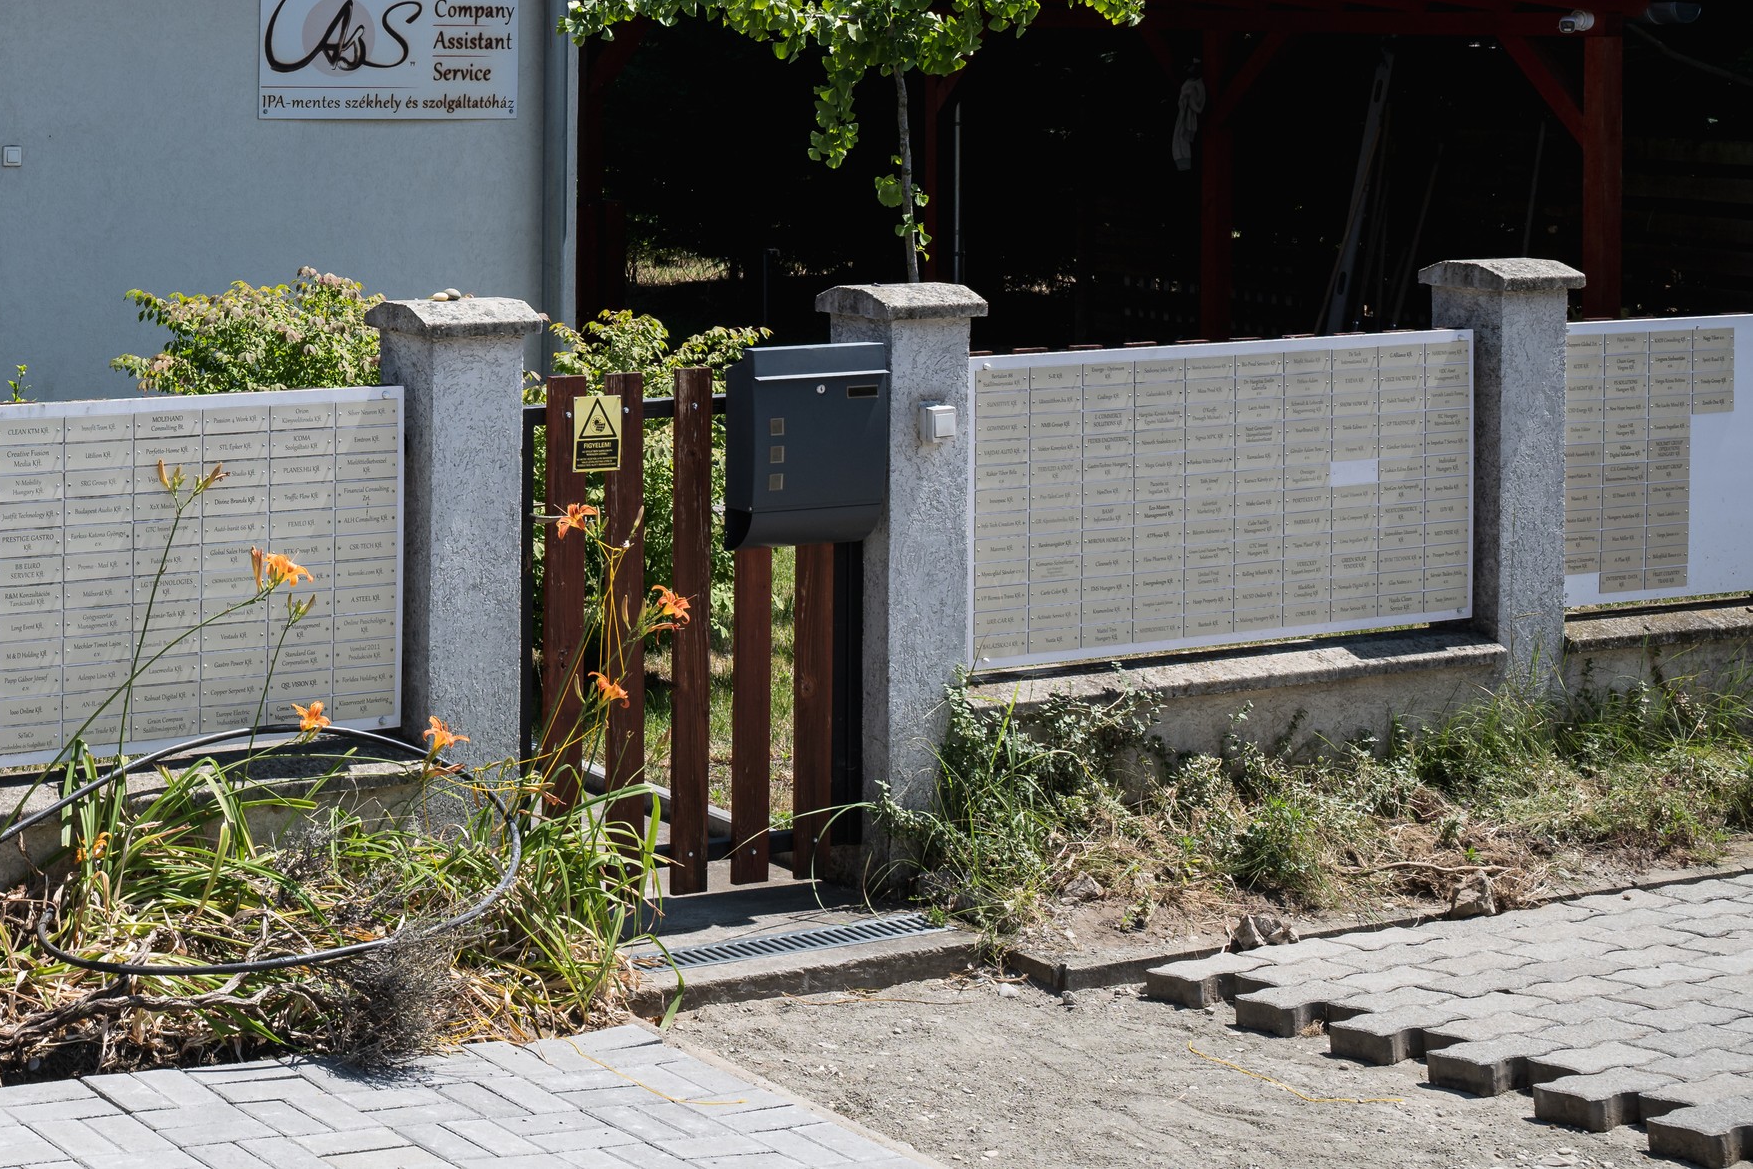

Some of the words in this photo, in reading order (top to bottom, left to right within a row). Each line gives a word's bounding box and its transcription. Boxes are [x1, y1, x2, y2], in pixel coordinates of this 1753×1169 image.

[435, 0, 515, 25] Company
[433, 31, 512, 50] Assistant
[433, 62, 491, 81] Service
[262, 94, 340, 109] IPA-mentes
[345, 94, 401, 113] székhely
[406, 94, 419, 109] és
[422, 93, 514, 113] szolgáltatóház
[152, 415, 184, 423] MOLEHAND
[151, 424, 177, 432] Consulting
[344, 486, 364, 494] Financial
[365, 485, 389, 493] Consulting
[284, 493, 298, 502] Traffic
[2, 535, 30, 543] PRESTIGE
[22, 651, 39, 659] Holding
[33, 674, 49, 683] József
[210, 689, 227, 697] Copper
